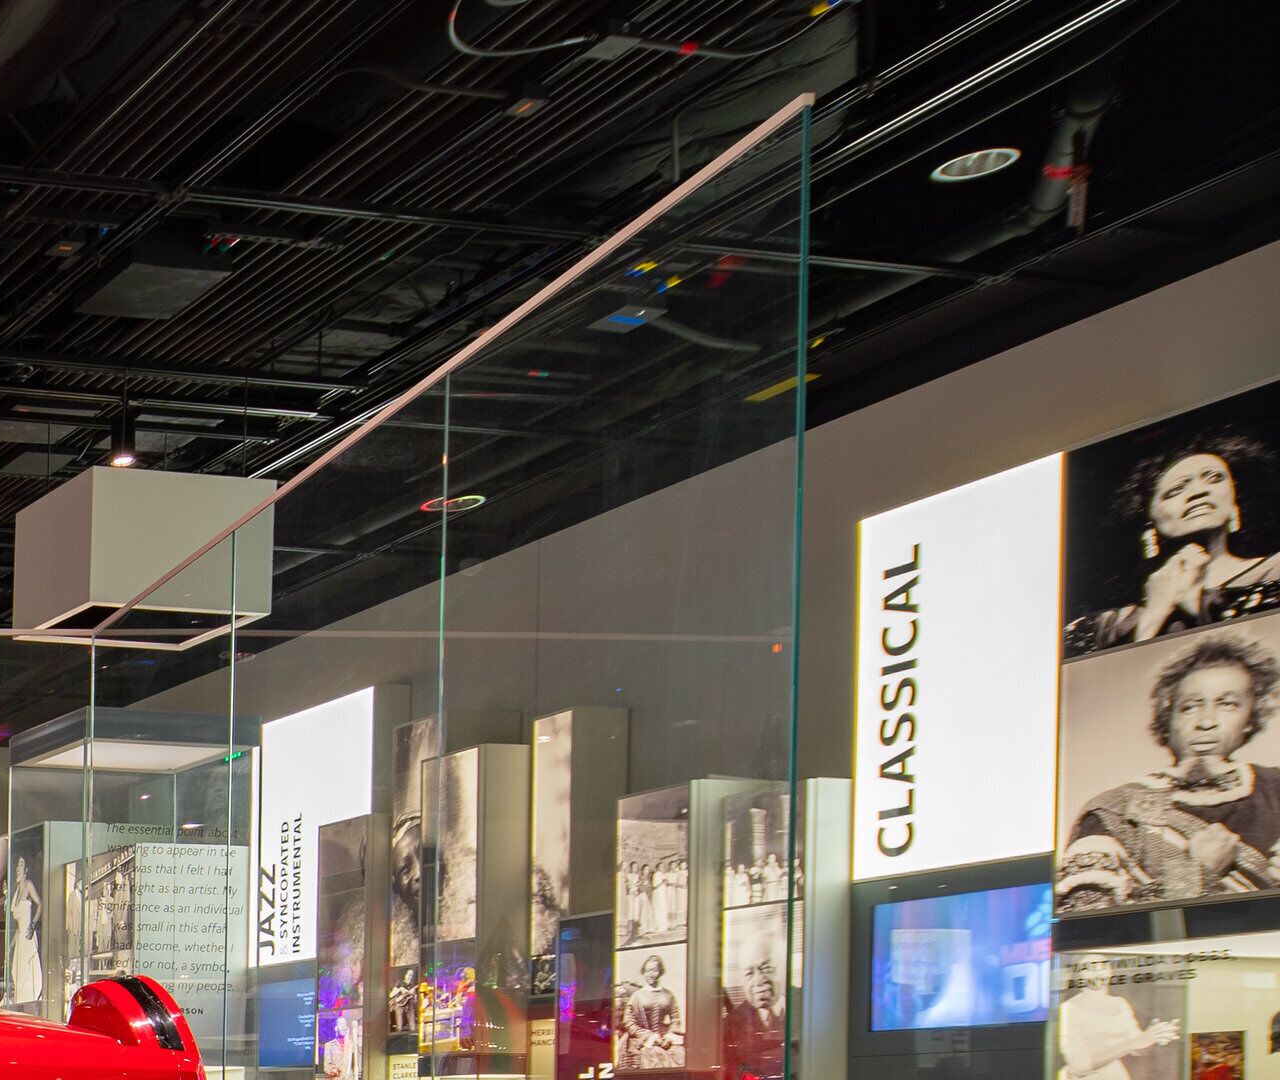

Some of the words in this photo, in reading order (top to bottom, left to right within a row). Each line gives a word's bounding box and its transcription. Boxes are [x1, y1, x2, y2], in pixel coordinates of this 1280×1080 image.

[876, 543, 922, 859] CLASSICAL
[106, 824, 125, 834] The
[128, 824, 174, 836] essential
[177, 828, 206, 839] point
[208, 828, 238, 838] abot
[153, 846, 163, 855] to
[167, 846, 204, 858] appear
[207, 846, 216, 856] in
[156, 864, 177, 874] that
[187, 864, 204, 875] felt
[280, 821, 289, 939] SYNCOPATED
[292, 813, 302, 953] INSTRUMENTAL
[188, 885, 219, 895] artist.
[178, 905, 190, 913] an
[260, 864, 275, 955] JAZZ
[137, 921, 163, 932] small
[166, 922, 175, 932] in
[180, 923, 199, 933] this
[185, 942, 226, 952] whethe
[143, 961, 154, 969] or
[157, 961, 178, 971] not,
[190, 962, 226, 974] symbo
[1132, 968, 1197, 984] GRAVES
[178, 982, 194, 993] my
[196, 982, 234, 994] peope.
[393, 1072, 418, 1080] CLARKE
